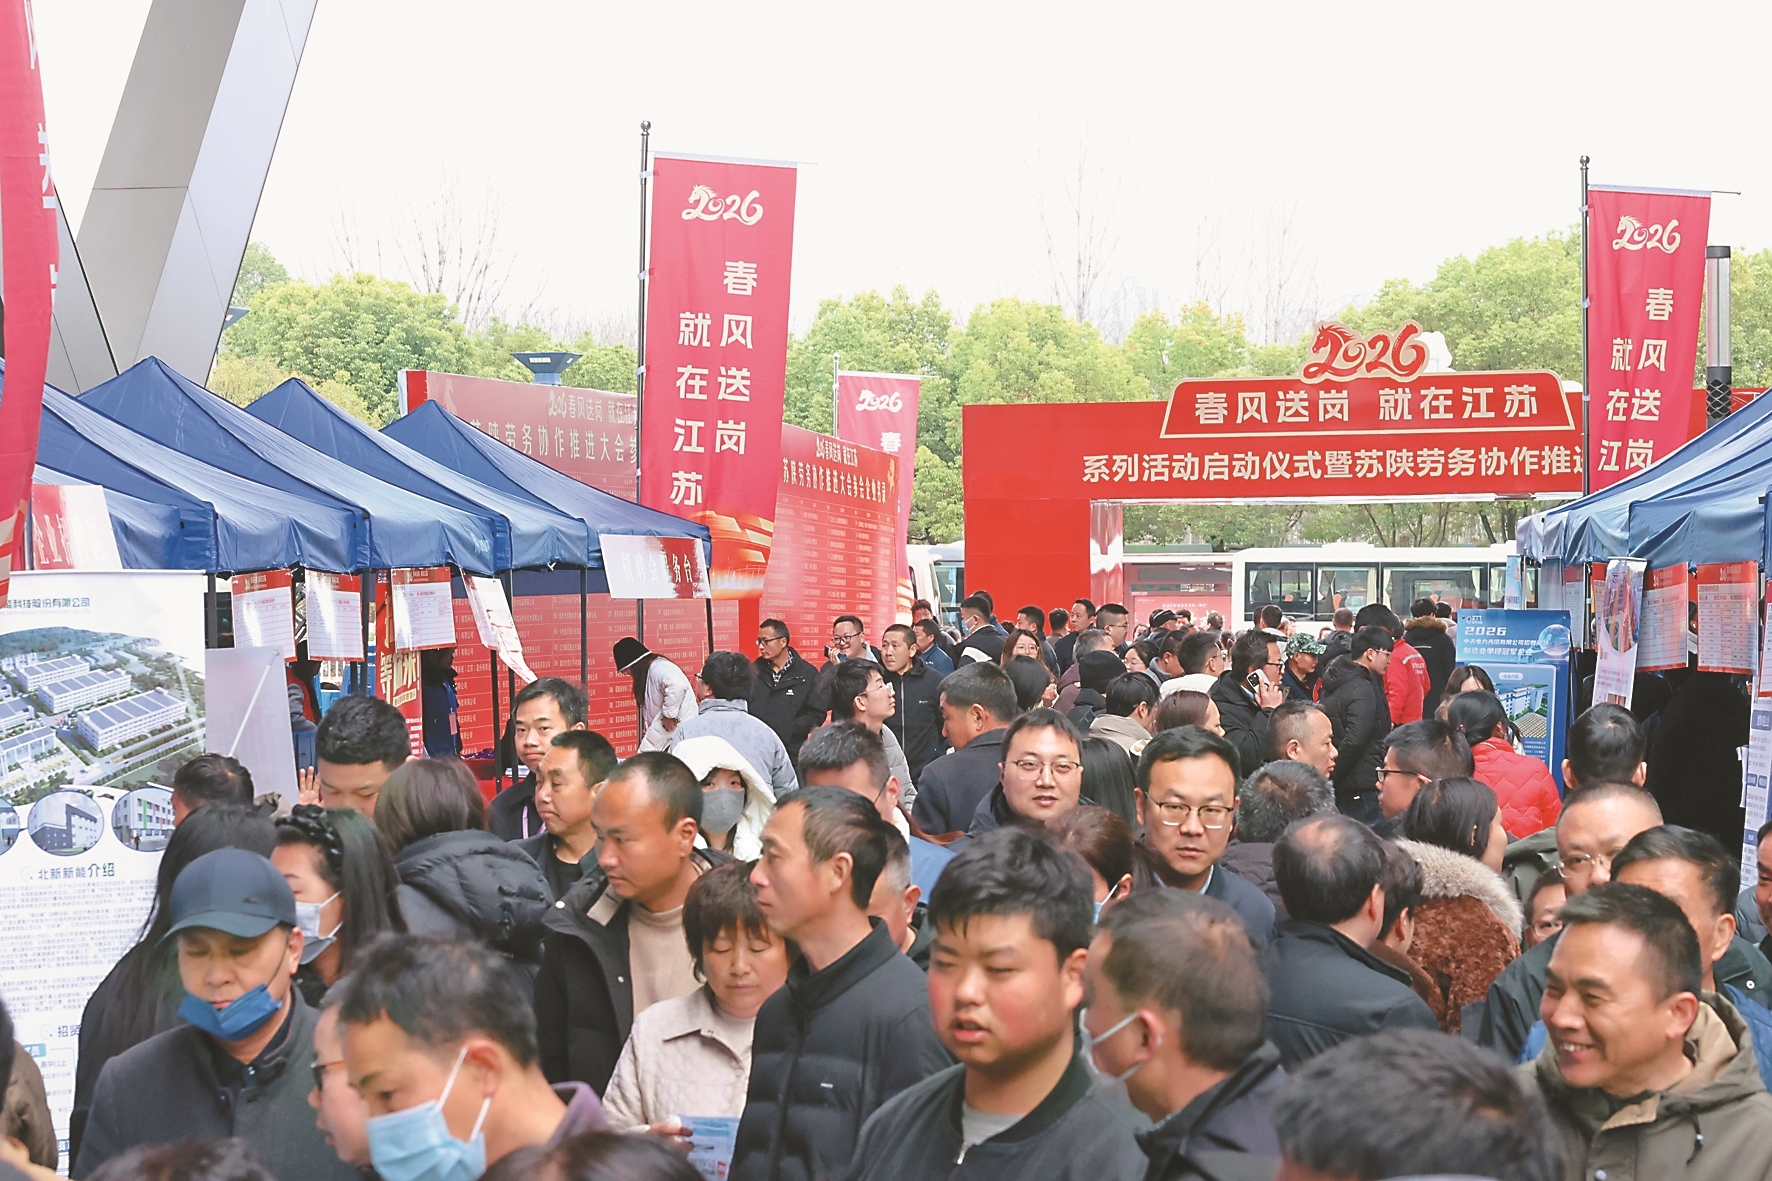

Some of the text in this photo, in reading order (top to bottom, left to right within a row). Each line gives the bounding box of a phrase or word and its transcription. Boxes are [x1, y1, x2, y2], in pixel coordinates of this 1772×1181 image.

[681, 183, 765, 226] 2026
[1611, 214, 1681, 254] 2026
[1302, 319, 1426, 378] 2026
[855, 389, 903, 413] 2026
[1194, 384, 1538, 426] 春风送岗 就在江苏
[1082, 443, 1583, 484] 系列活动启动仪式暨苏陕劳务协作推
[1464, 626, 1507, 636] 2026
[38, 862, 115, 880] 北新新能介绍
